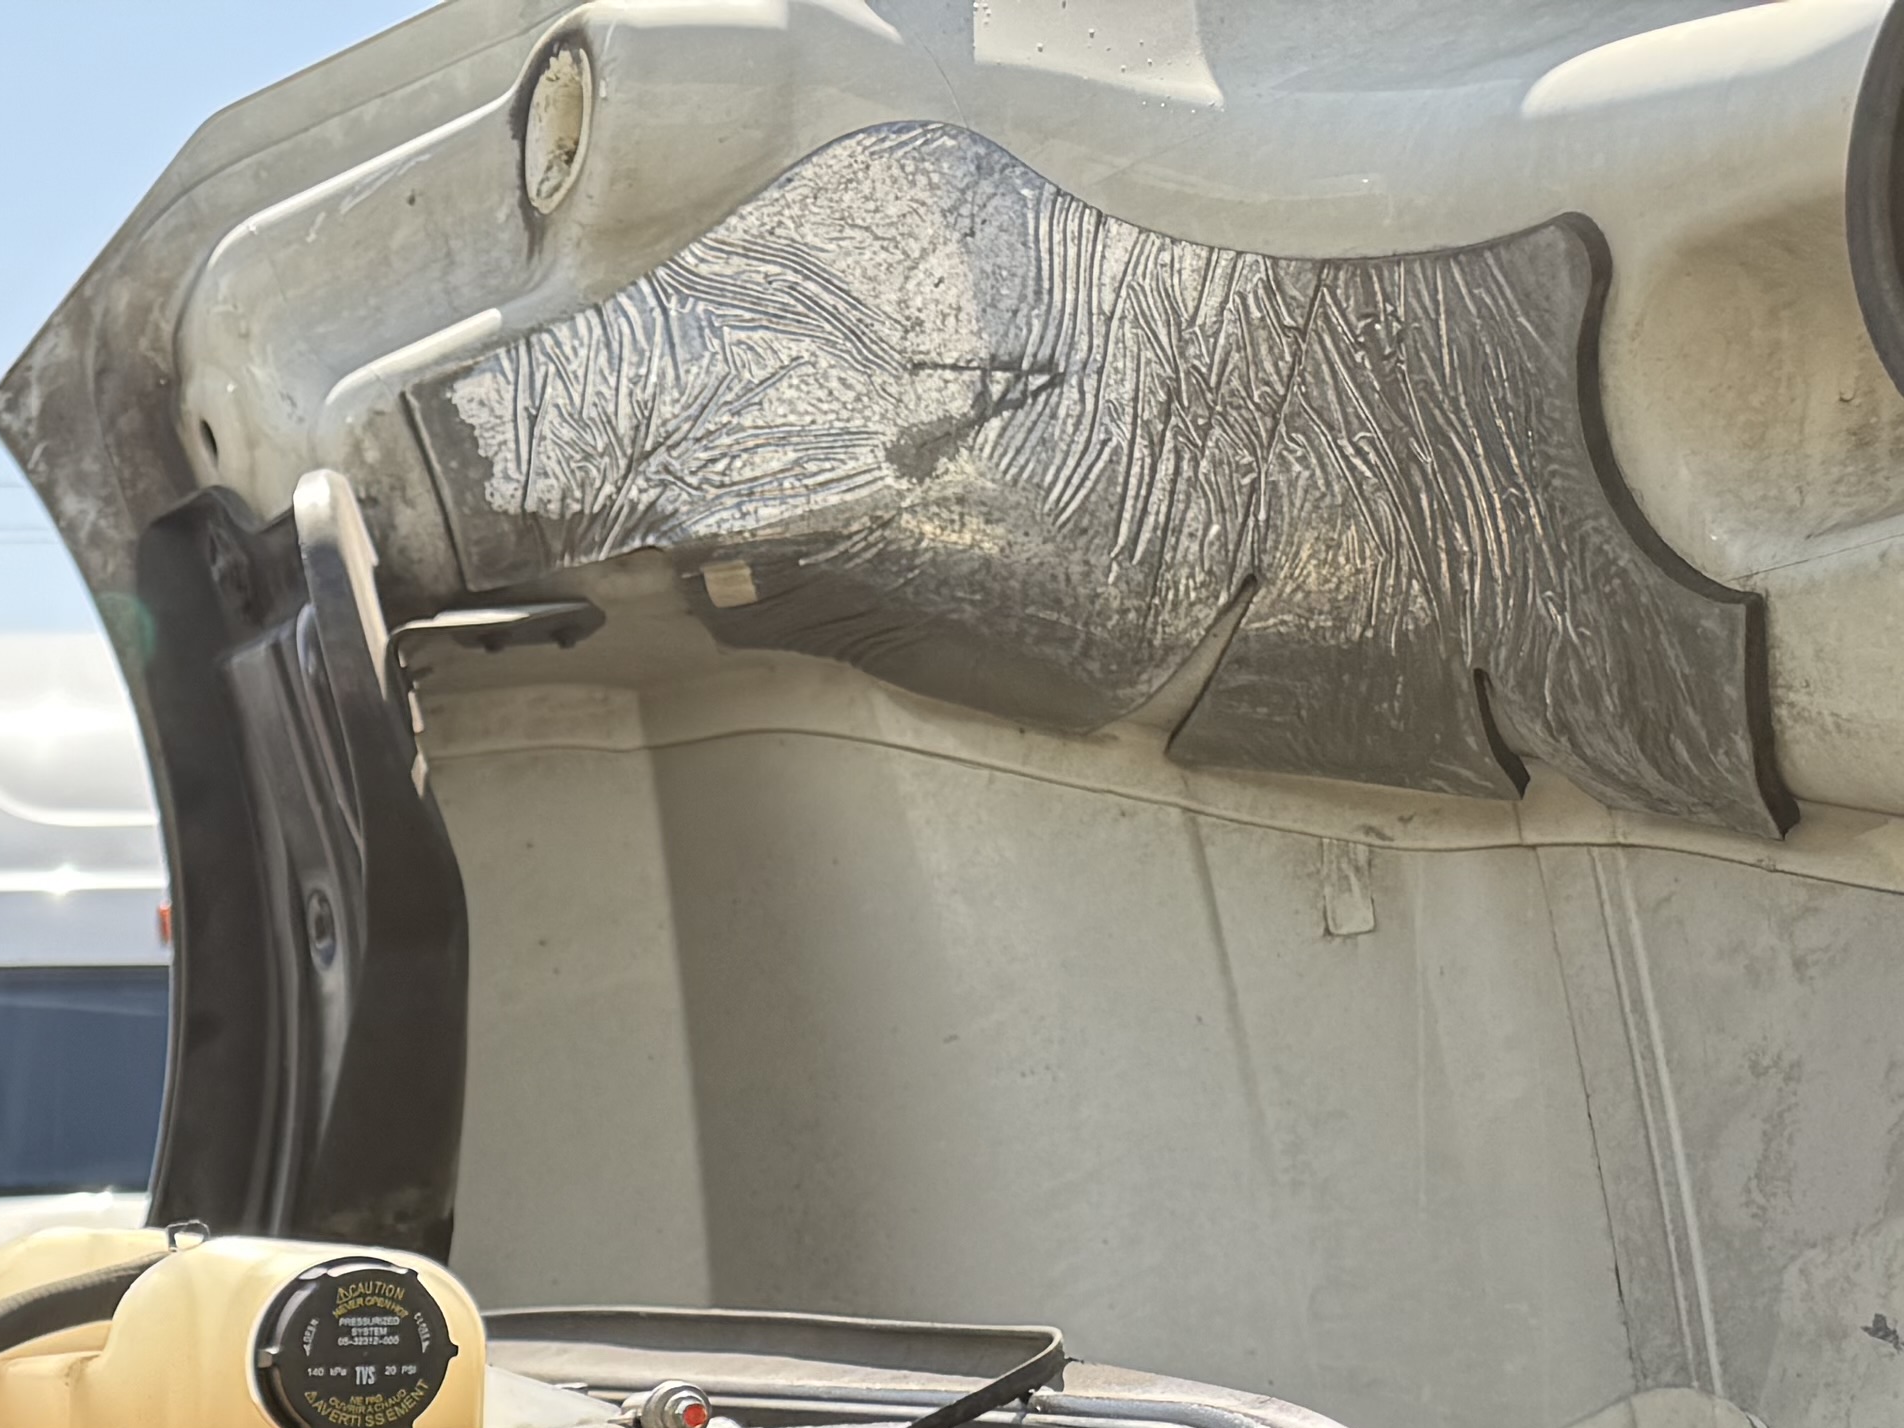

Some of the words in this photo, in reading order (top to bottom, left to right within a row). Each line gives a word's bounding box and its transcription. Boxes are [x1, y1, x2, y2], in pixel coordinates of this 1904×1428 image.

[349, 1281, 405, 1300] CAUTION
[333, 1297, 364, 1318] NEVER
[365, 1296, 391, 1309] OPEN
[339, 1317, 400, 1326] PRESSURIZED
[351, 1327, 387, 1336] SYSTEM
[307, 1367, 324, 1376] 140
[355, 1366, 376, 1385] TVS
[384, 1366, 397, 1375] 20
[401, 1365, 417, 1374] PSI
